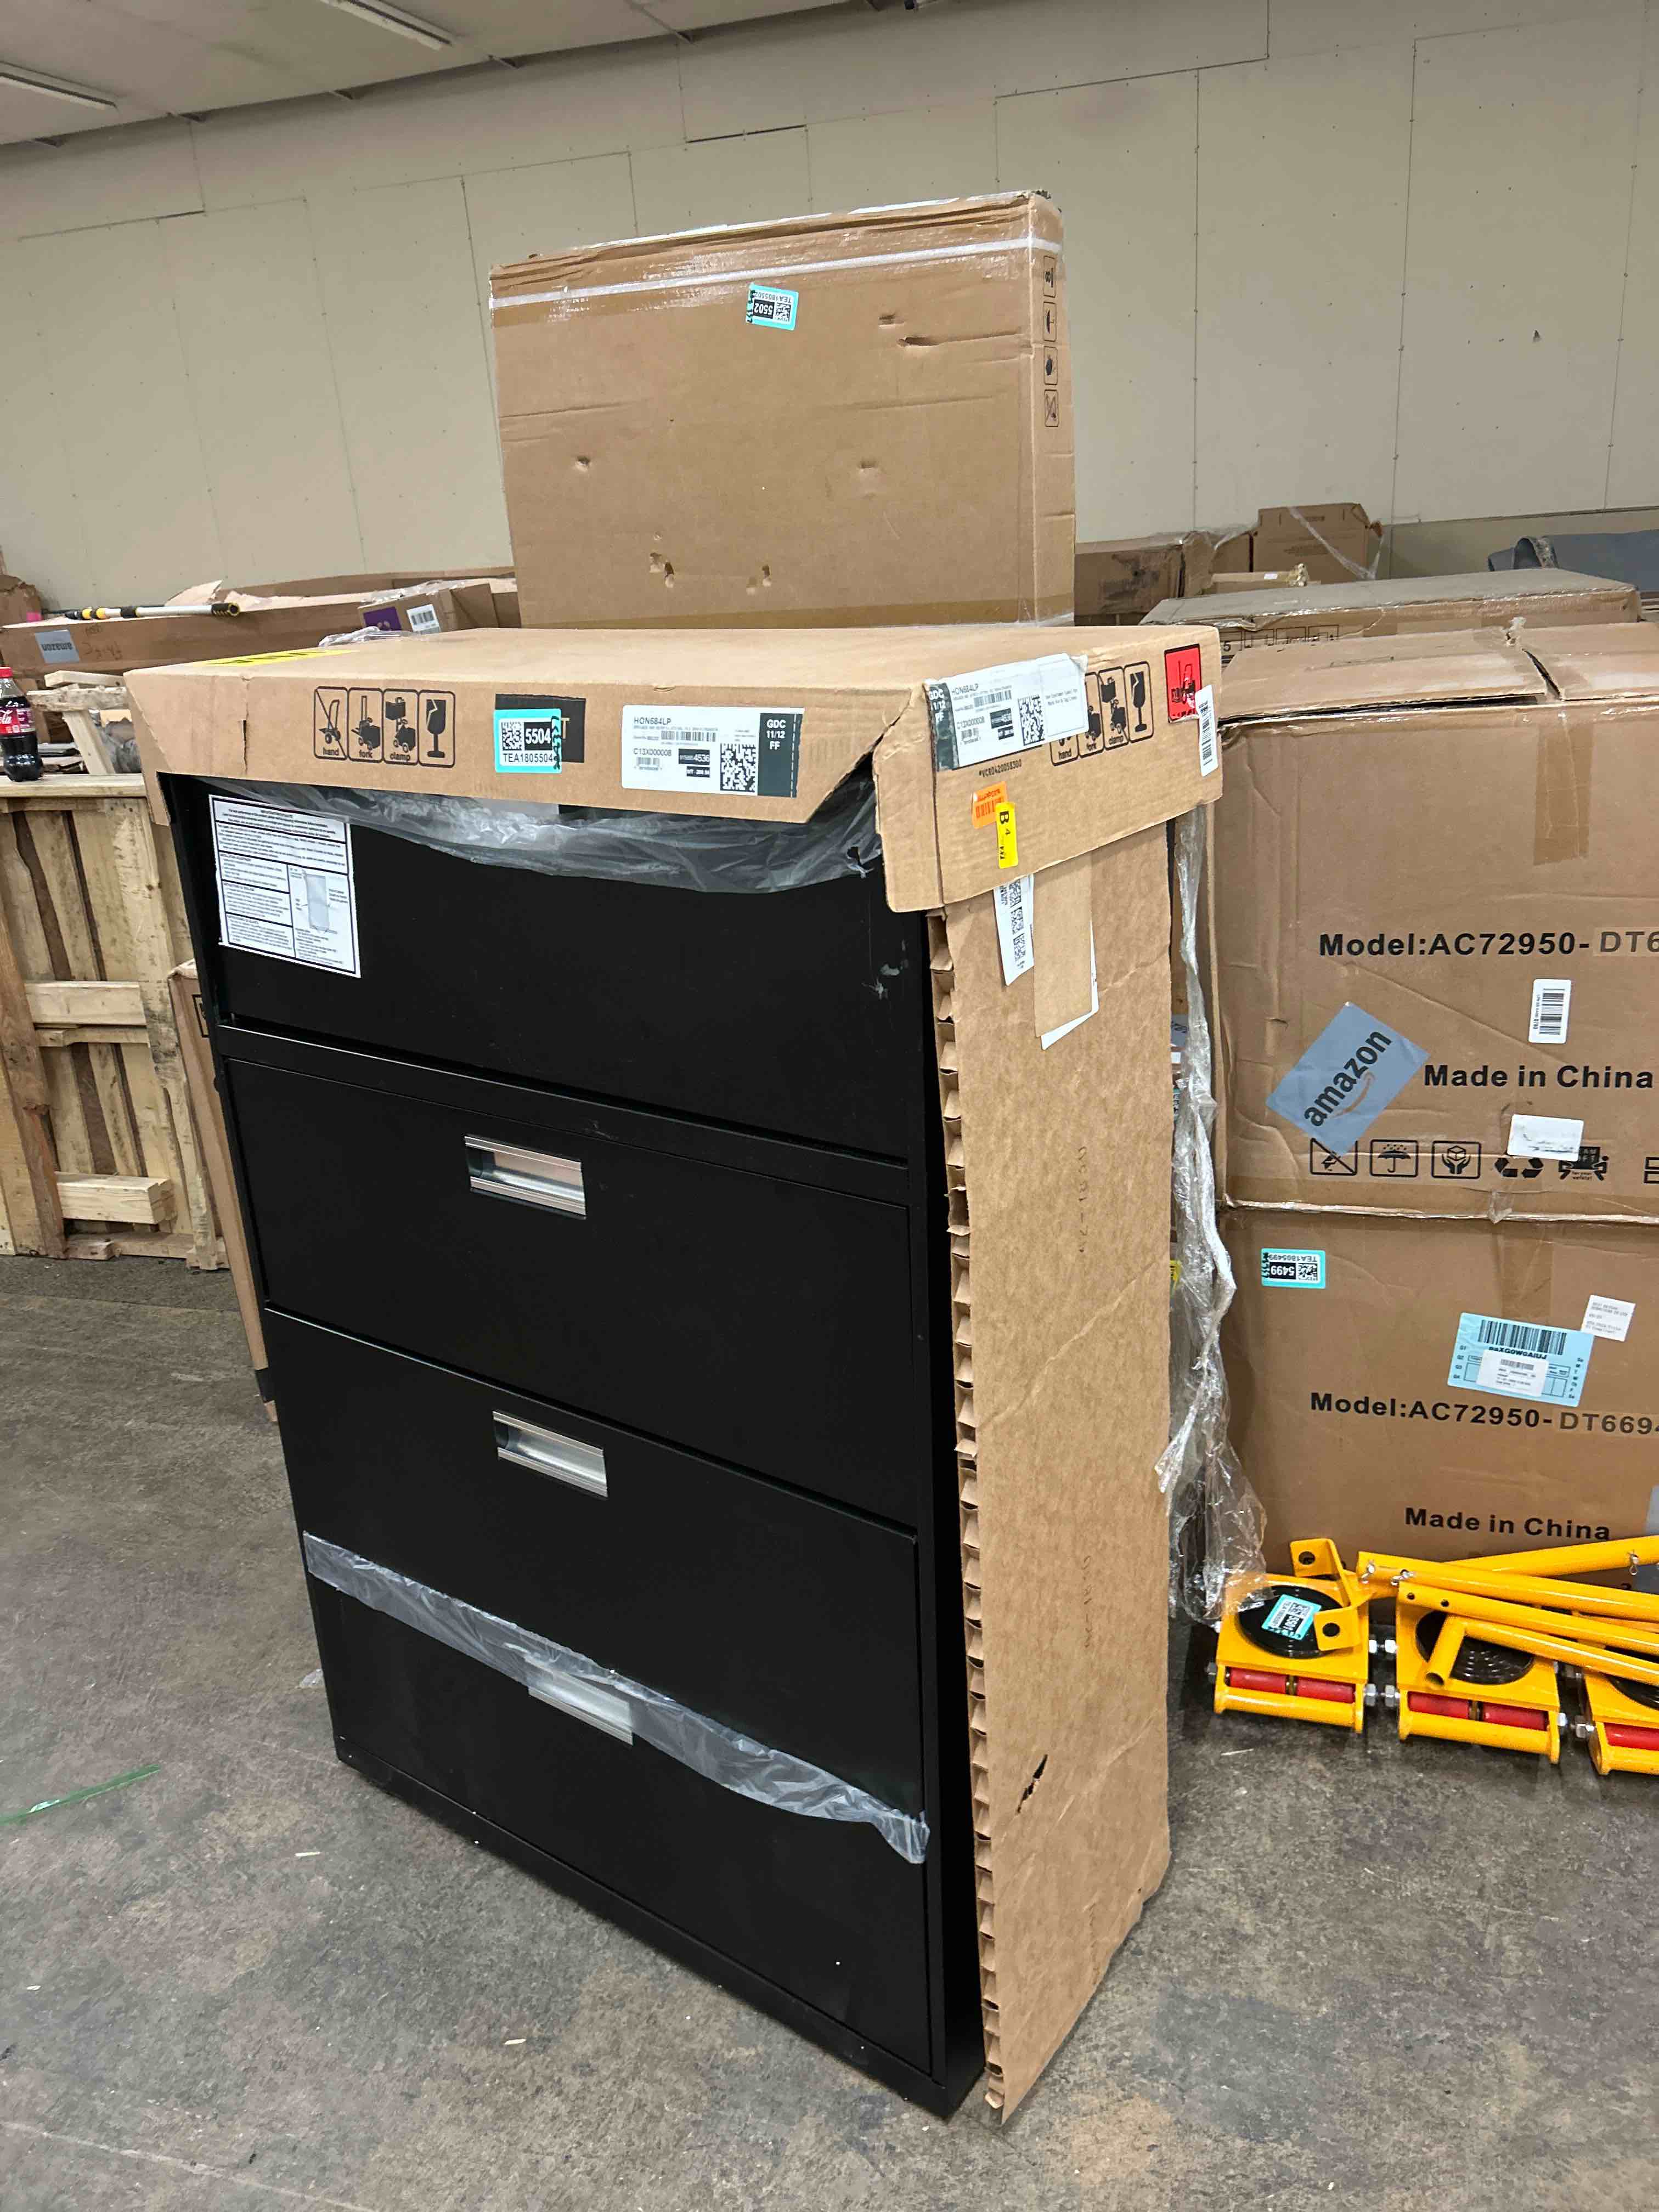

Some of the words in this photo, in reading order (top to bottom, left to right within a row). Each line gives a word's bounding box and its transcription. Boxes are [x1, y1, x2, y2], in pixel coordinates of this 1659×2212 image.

[754, 303, 774, 315] 5502
[41, 641, 74, 652] amazon
[928, 689, 944, 701] GDC
[766, 719, 786, 729] GDC
[525, 728, 551, 744] 5504
[766, 730, 786, 739] 11/12
[1109, 735, 1124, 745] clamp
[770, 741, 780, 750] FF
[1086, 742, 1097, 751] fork
[323, 747, 340, 756] hand
[359, 749, 373, 759] fork
[390, 752, 411, 762] clamp
[1058, 749, 1072, 760] hand
[503, 753, 553, 763] TEA1805504
[1000, 811, 1009, 825] B
[1304, 1029, 1392, 1127] amazon
[1425, 1064, 1508, 1087] Made
[1519, 1065, 1545, 1087] in
[1557, 1065, 1654, 1088] China
[1268, 1254, 1318, 1262] TEA1805499
[1270, 1265, 1295, 1276] 5499
[1559, 1412, 1659, 1435] DT669
[1405, 1507, 1480, 1531] Made
[1489, 1514, 1515, 1534] in
[1523, 1517, 1611, 1541] China
